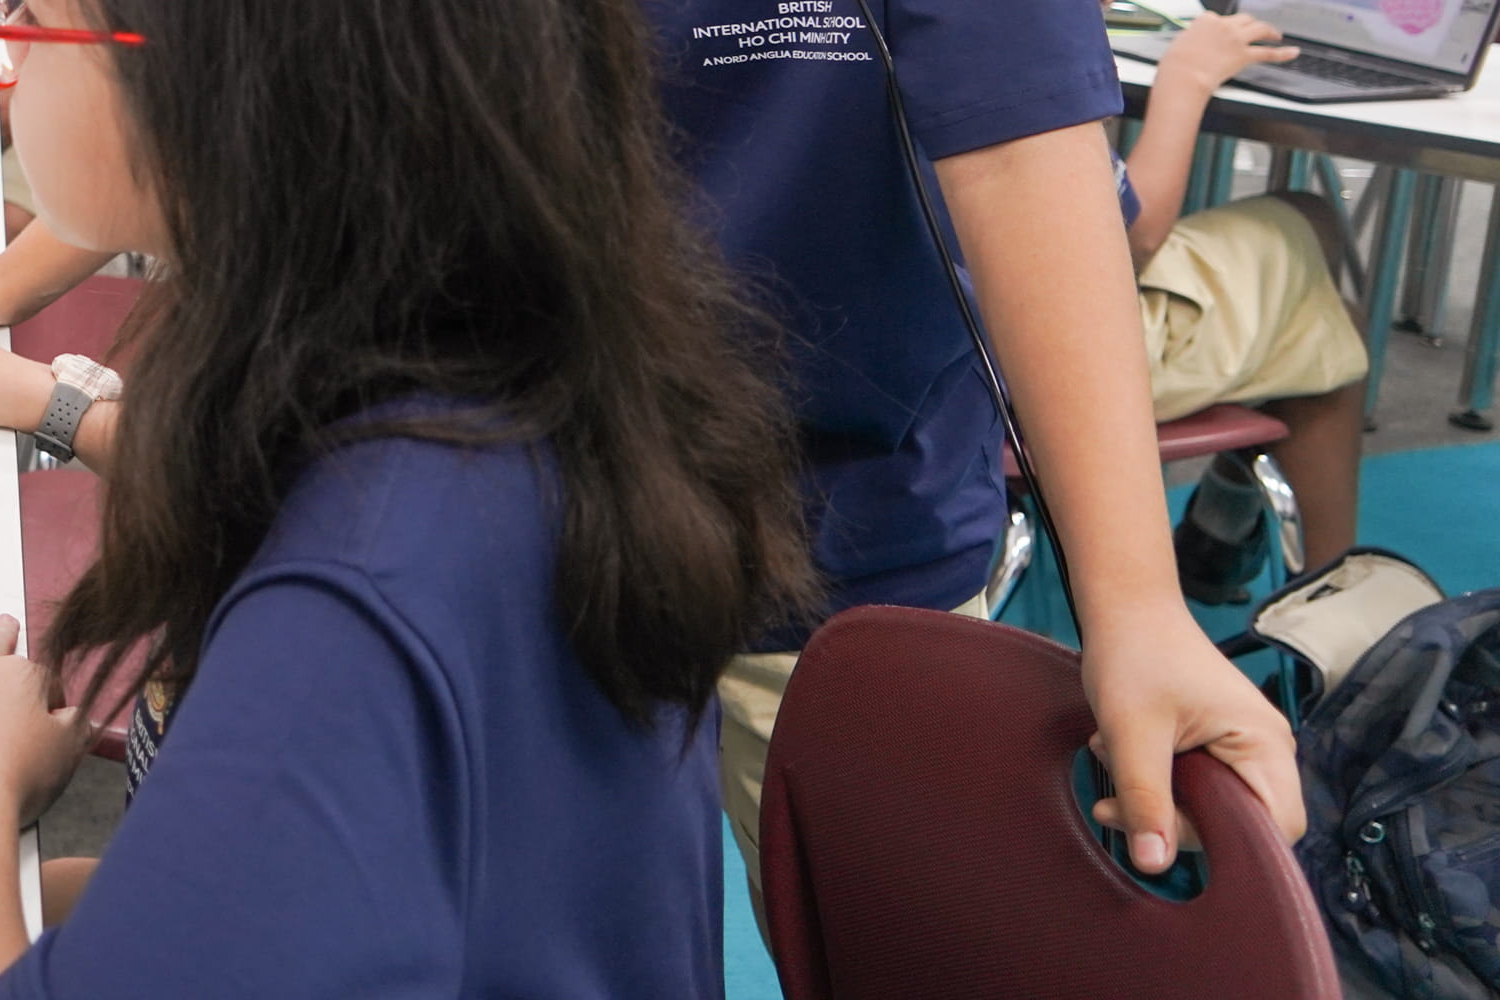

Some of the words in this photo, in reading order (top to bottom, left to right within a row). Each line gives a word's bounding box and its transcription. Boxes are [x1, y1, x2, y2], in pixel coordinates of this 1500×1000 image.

[778, 1, 833, 14] BRITISH
[692, 16, 822, 39] INTERNATIONAL
[738, 35, 765, 48] HO
[768, 31, 797, 45] CHI
[703, 57, 714, 67] A
[714, 54, 748, 65] NORD
[749, 50, 792, 61] ANGLIA
[827, 52, 873, 61] SCHOOL
